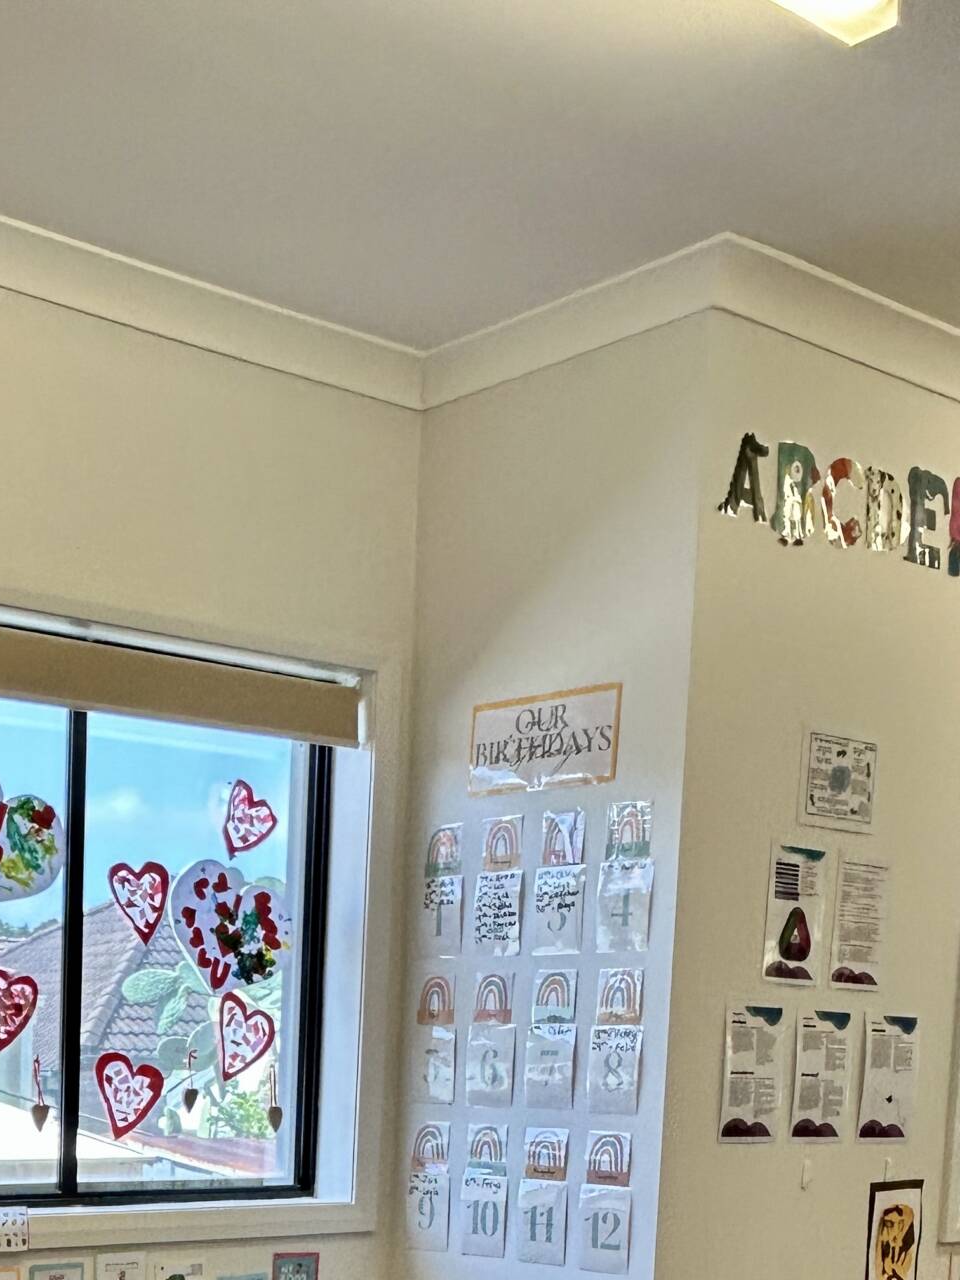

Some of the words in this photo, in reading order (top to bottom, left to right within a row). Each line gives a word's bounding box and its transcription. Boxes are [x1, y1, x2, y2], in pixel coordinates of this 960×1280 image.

[515, 704, 568, 735] OUR
[467, 1200, 499, 1236] 10
[523, 1205, 554, 1243] 11
[584, 1211, 621, 1251] 12
